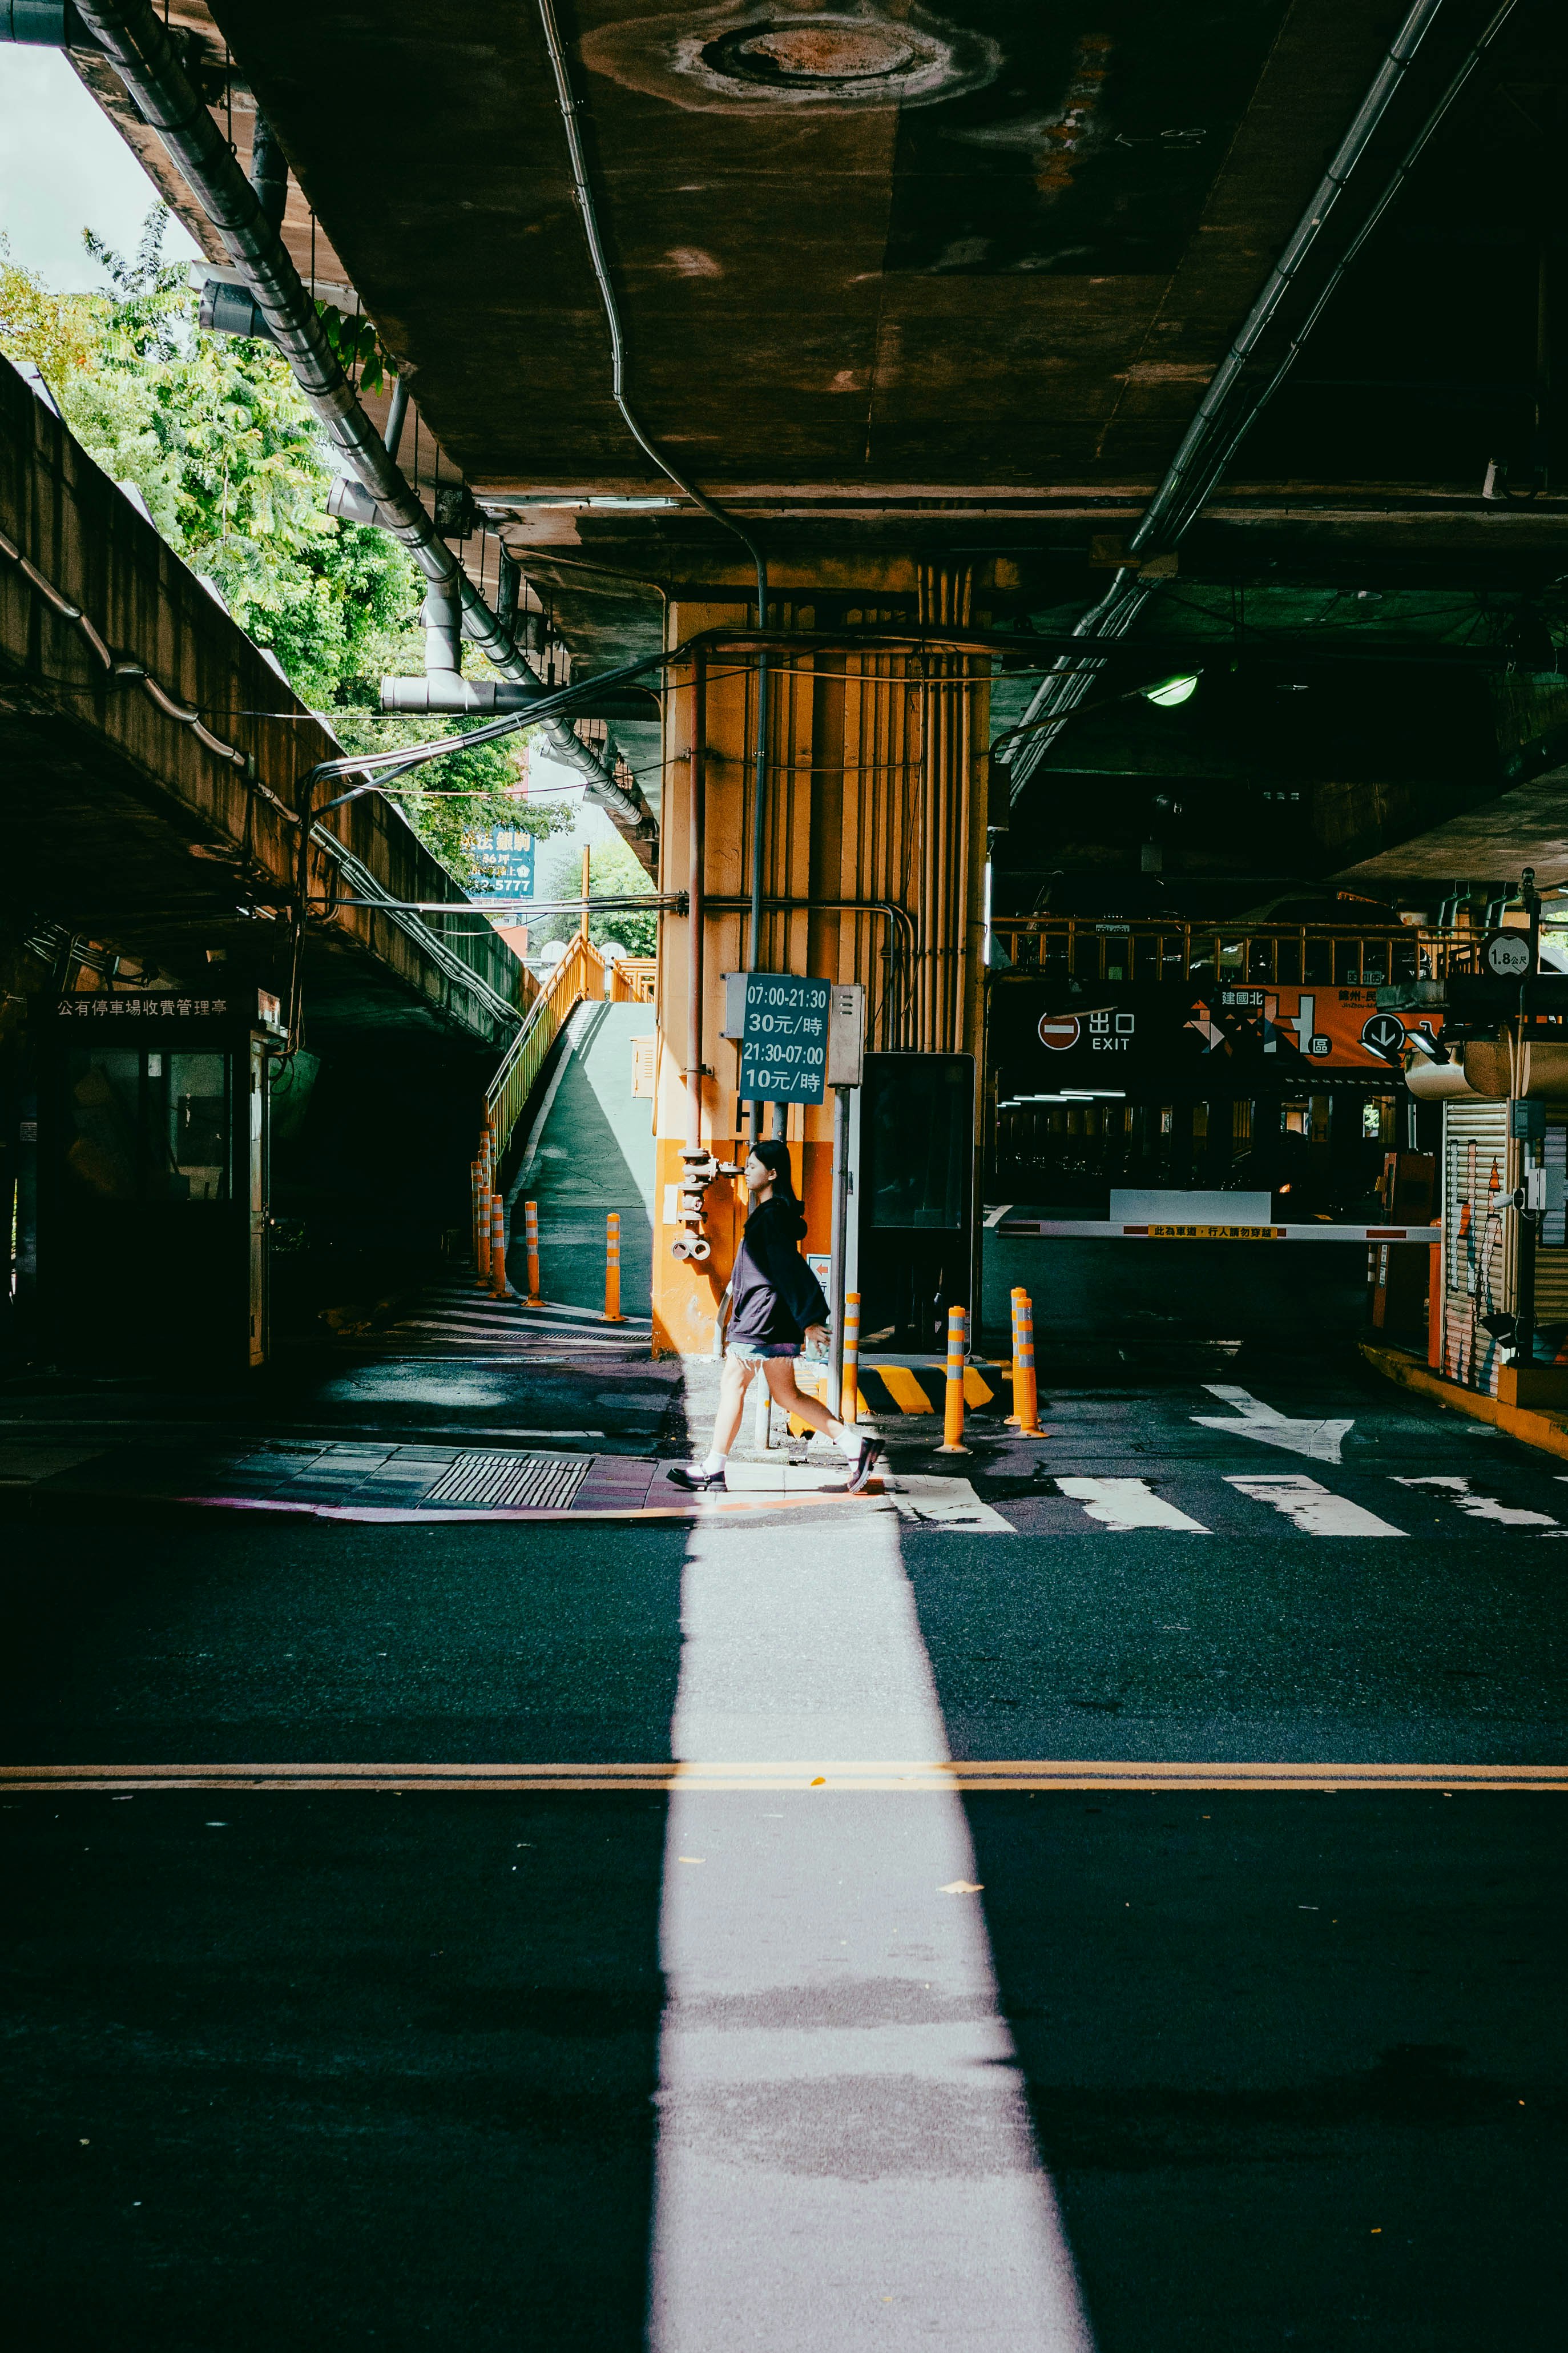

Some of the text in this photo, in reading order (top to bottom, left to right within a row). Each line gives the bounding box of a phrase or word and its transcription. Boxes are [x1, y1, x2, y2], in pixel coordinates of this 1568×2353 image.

[1492, 949, 1527, 964] 1.8公尺
[748, 986, 826, 1009] 07:00-21:30
[1222, 991, 1263, 1006] 建國北
[57, 999, 227, 1017] 公有停車場收費管理亭
[749, 1013, 823, 1036] 30元/時
[1089, 1012, 1135, 1033] 出口
[1093, 1038, 1130, 1050] EXIT
[1313, 1038, 1328, 1053] 區
[744, 1043, 824, 1065] 21:30-07:00
[746, 1069, 820, 1092] 10元/時
